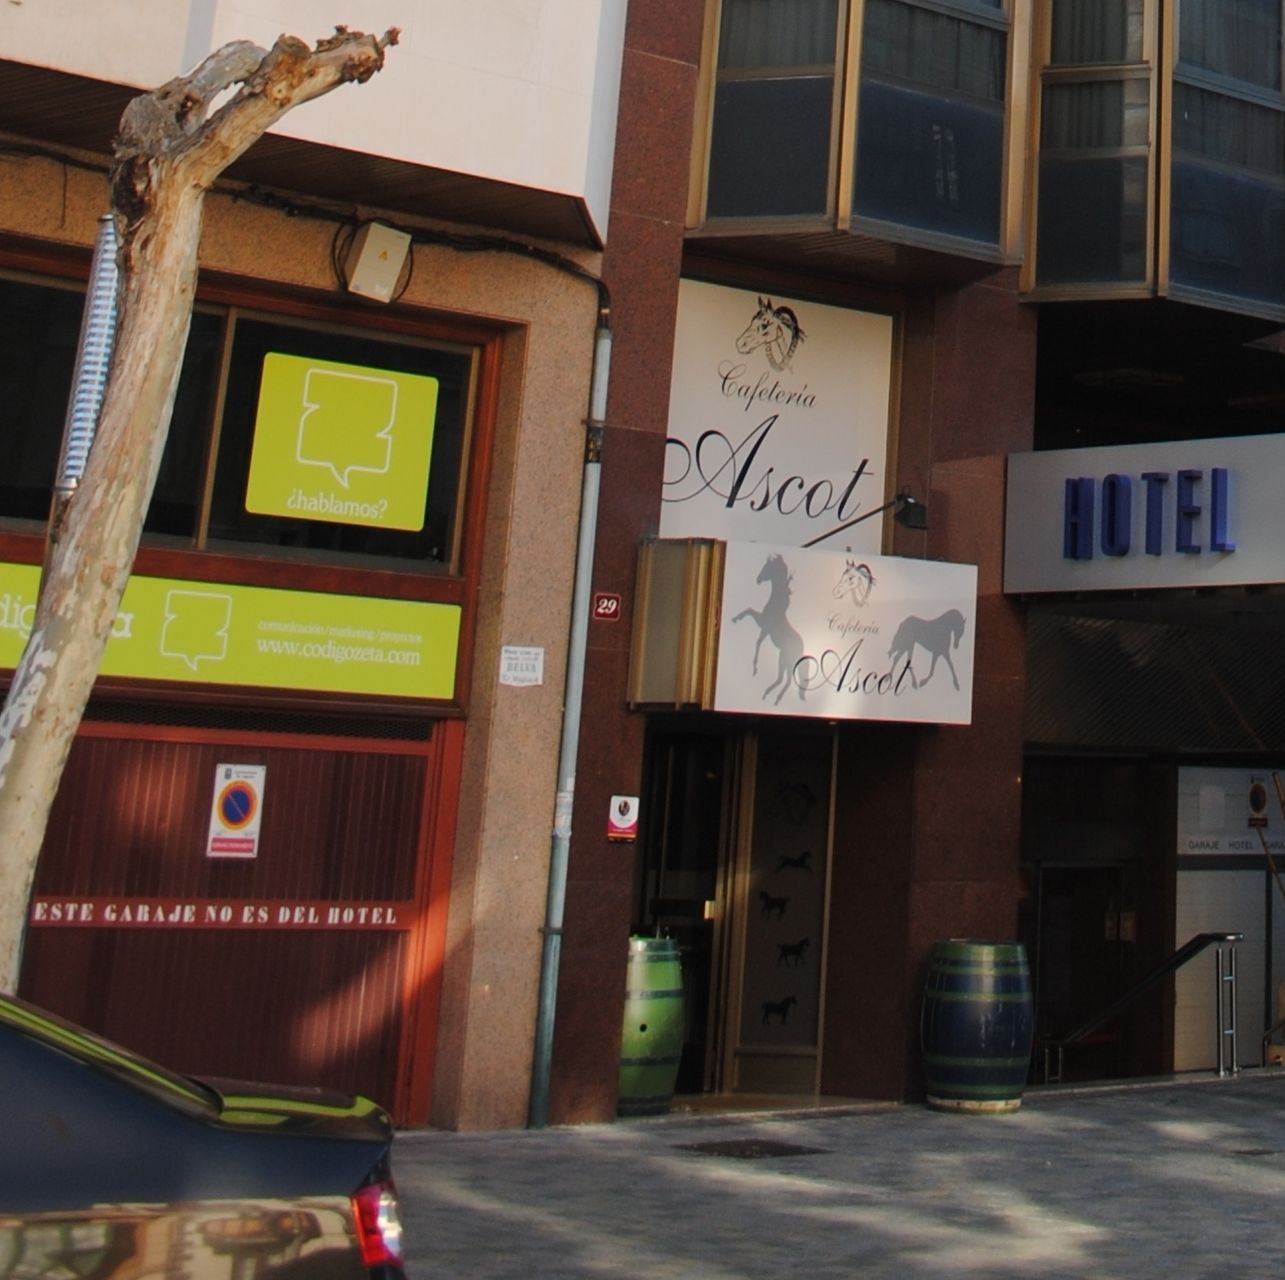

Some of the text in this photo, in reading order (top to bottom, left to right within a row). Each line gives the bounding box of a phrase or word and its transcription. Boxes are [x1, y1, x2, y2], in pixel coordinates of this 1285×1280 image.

[718, 360, 817, 412] Cafetería
[662, 414, 875, 522] Ascot
[287, 489, 388, 519] ¿hablamos?
[1063, 467, 1238, 560] HOTEL
[596, 598, 618, 614] 29
[256, 639, 421, 666] www.codigozeta.com
[792, 638, 913, 696] Ascot
[1188, 840, 1220, 850] GARAJE
[34, 902, 397, 925] ESTE GARAJE NO ES DEL HOTEL
